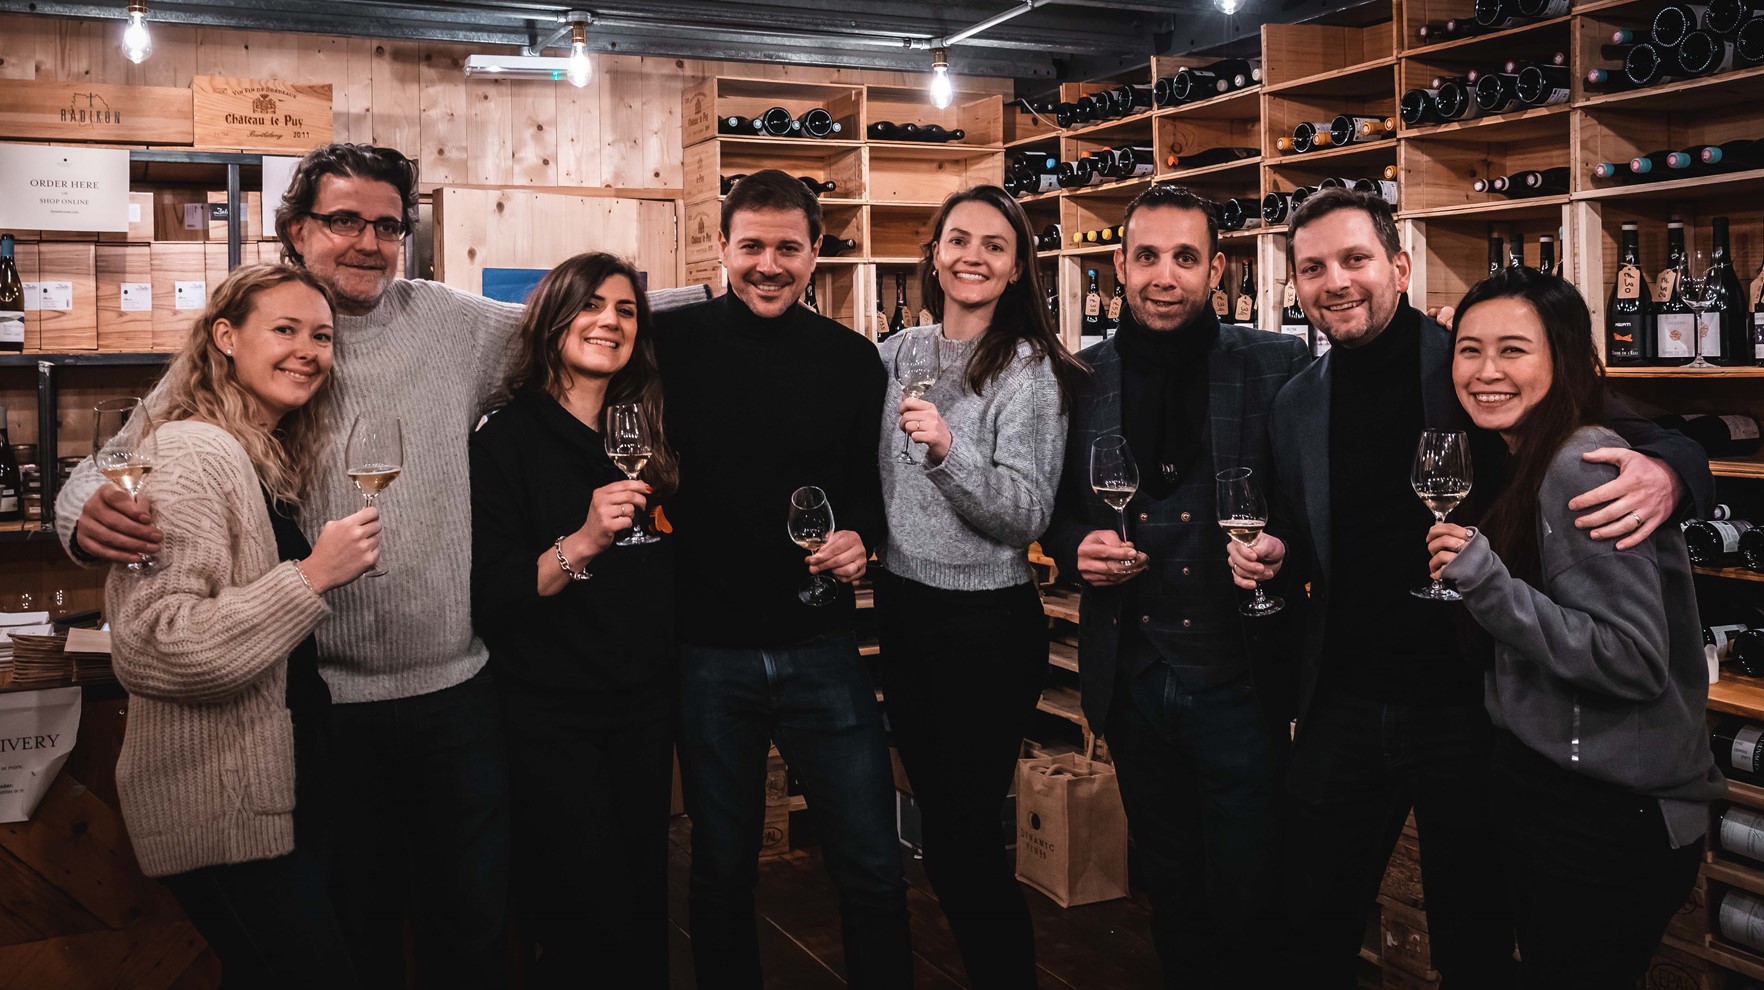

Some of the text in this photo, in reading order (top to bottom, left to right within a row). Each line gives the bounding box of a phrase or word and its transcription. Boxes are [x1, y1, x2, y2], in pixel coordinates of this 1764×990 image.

[60, 108, 120, 124] RADIKON
[225, 113, 265, 126] Château
[284, 114, 303, 128] Puy
[30, 179, 99, 190] ORDER HERE
[1021, 829, 1054, 852] DYNAMIC
